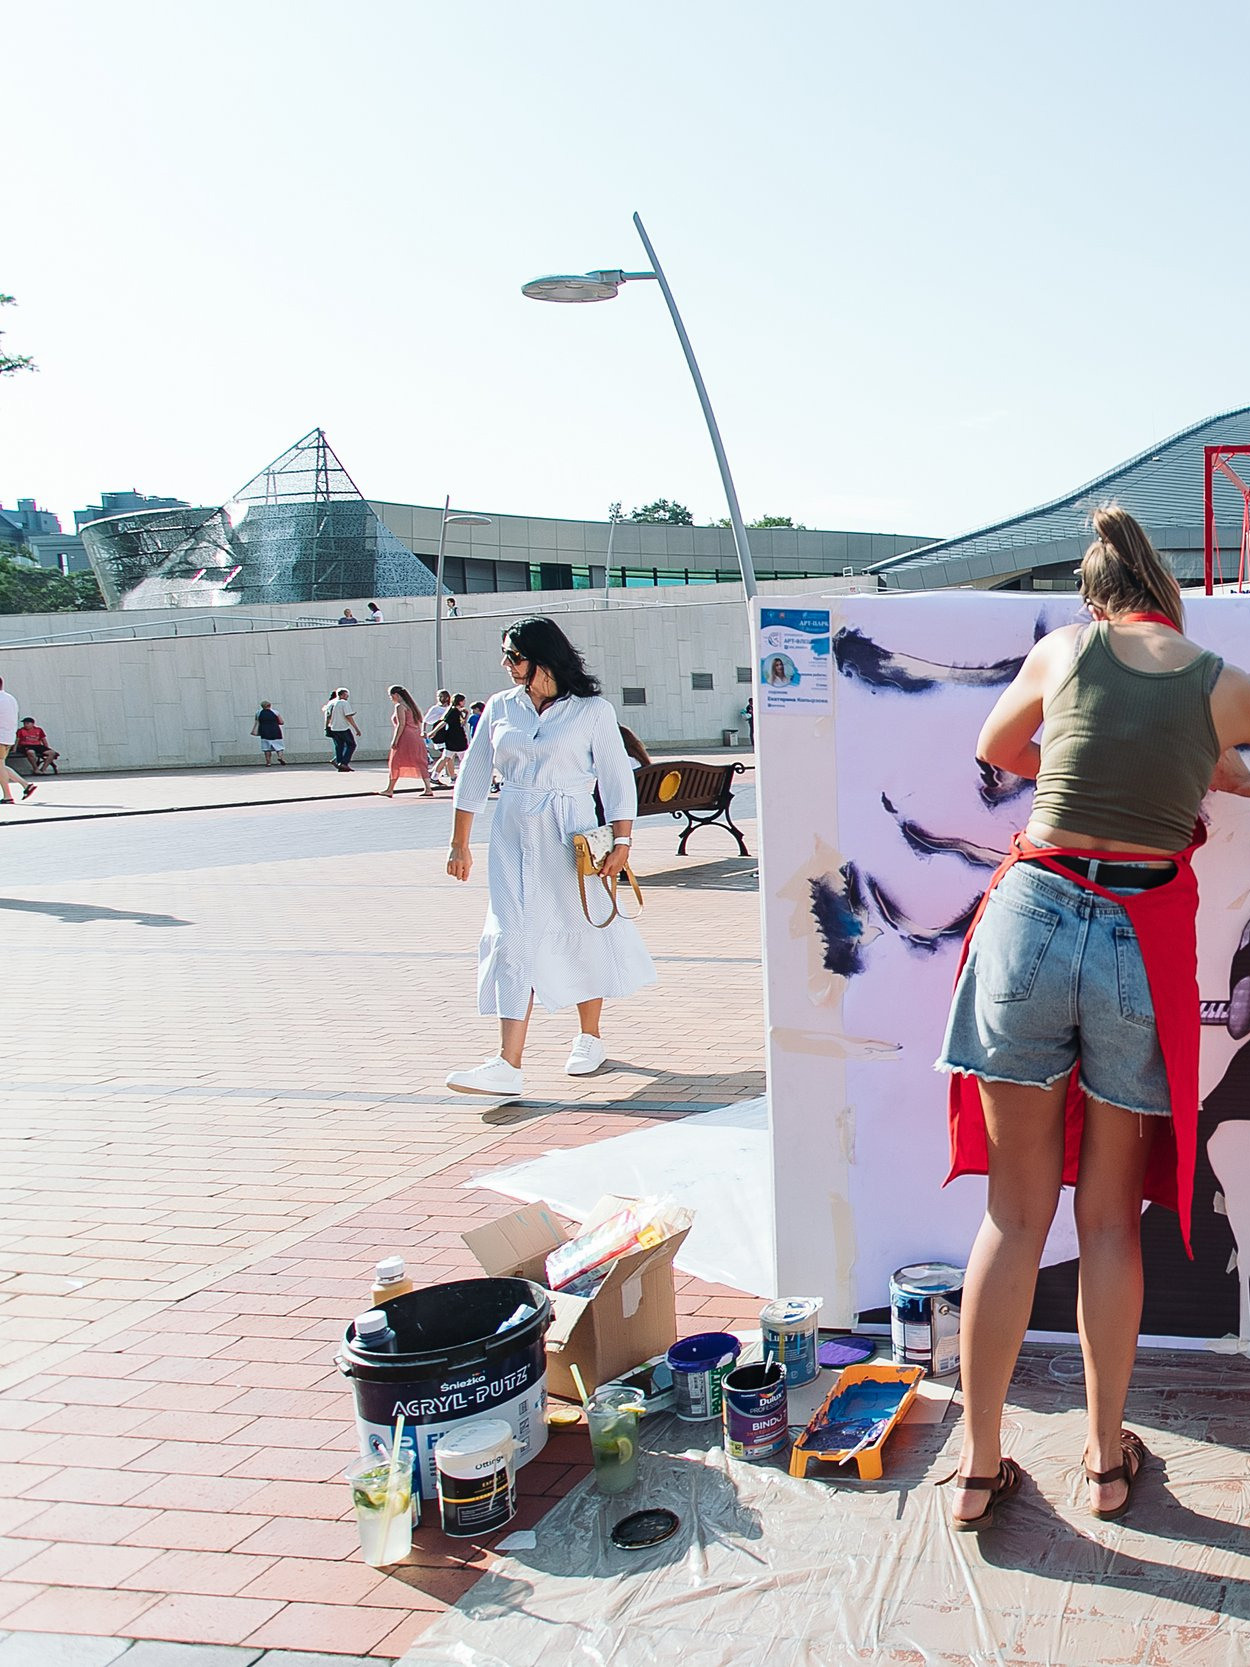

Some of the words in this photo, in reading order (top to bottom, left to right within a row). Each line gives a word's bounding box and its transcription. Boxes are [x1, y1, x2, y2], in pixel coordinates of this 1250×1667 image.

[769, 1333, 788, 1342] Lua
[759, 1393, 782, 1407] Dulux
[752, 1413, 783, 1431] BINDO
